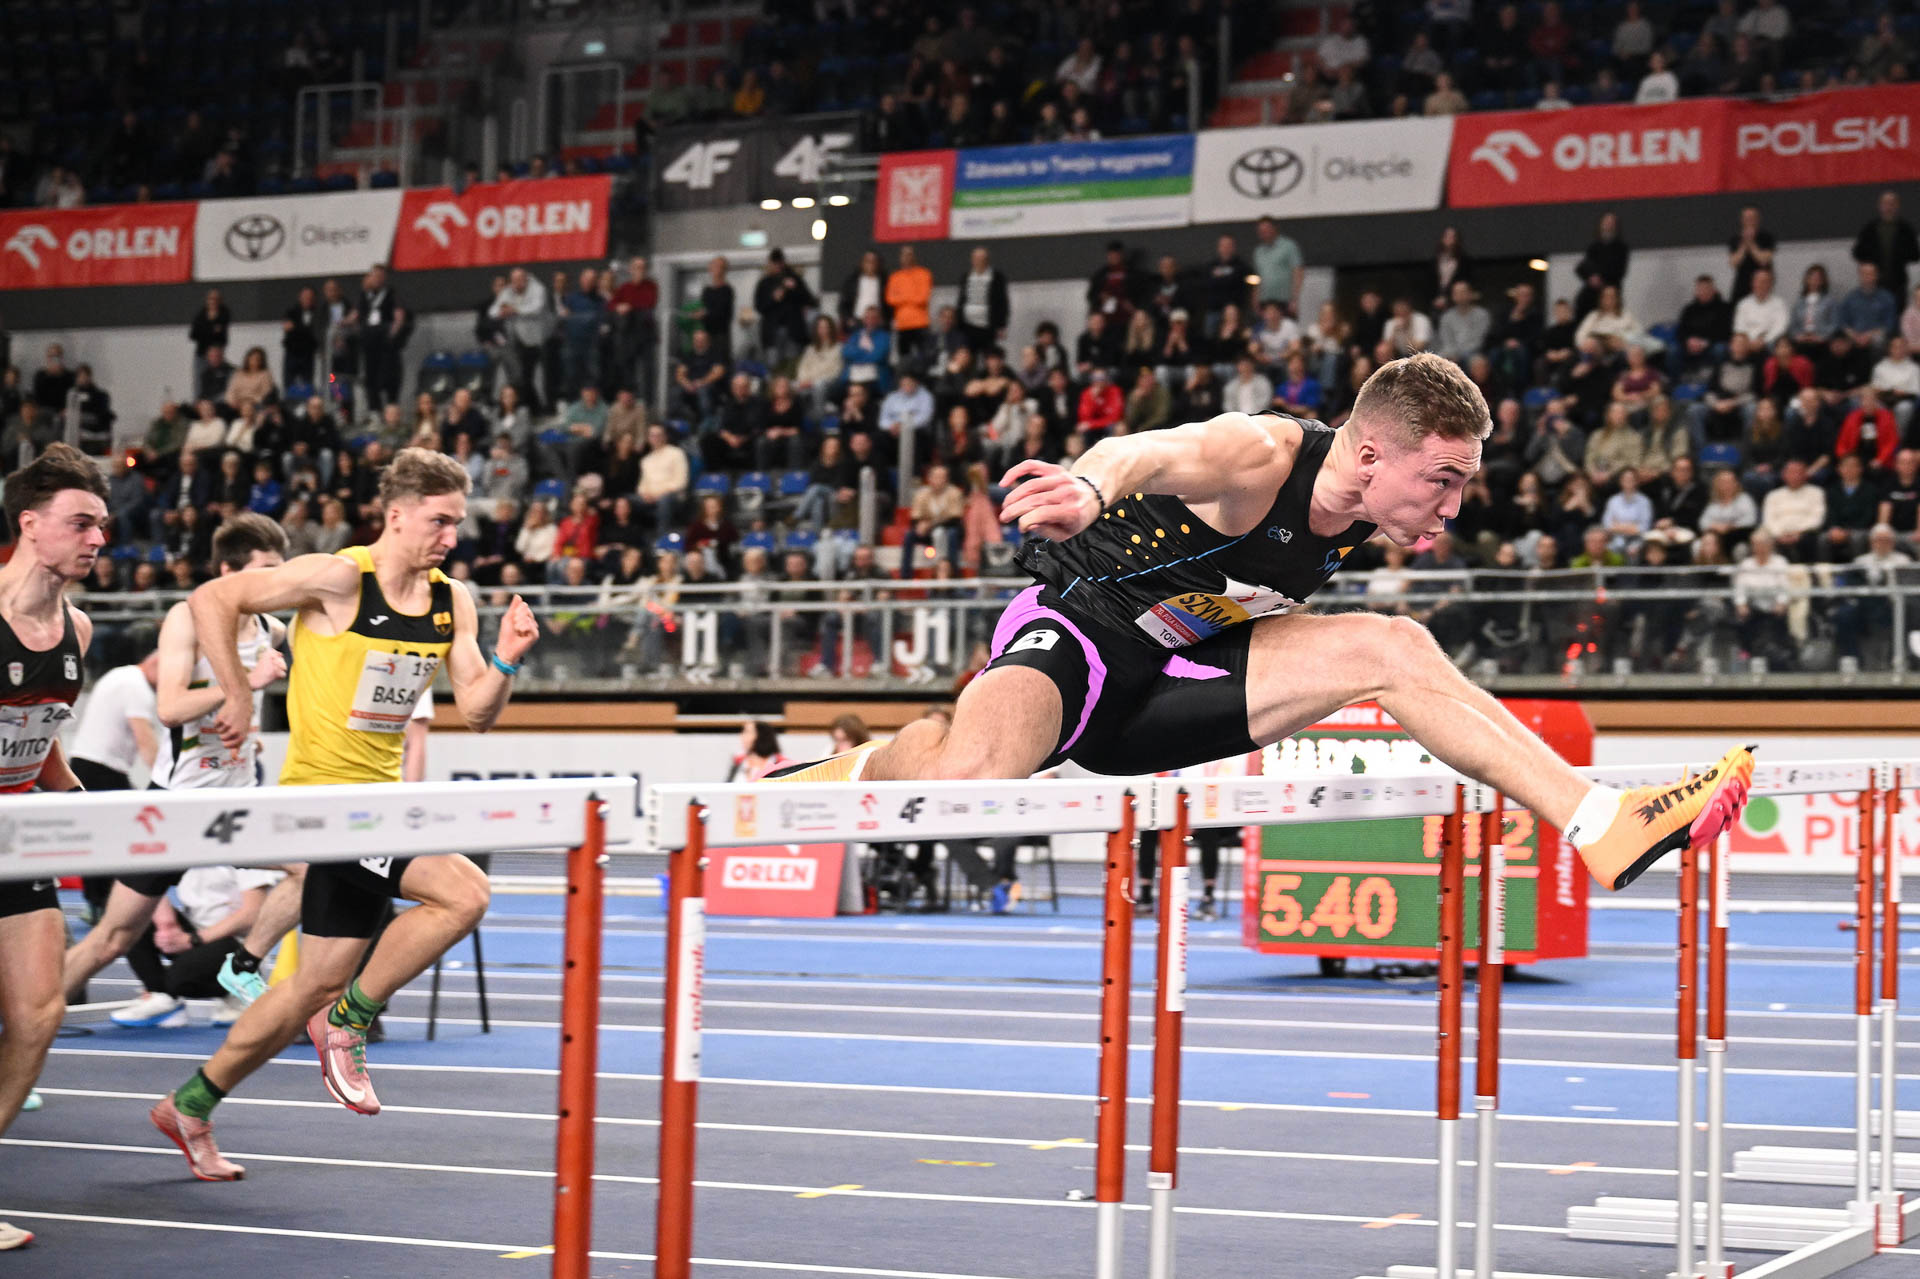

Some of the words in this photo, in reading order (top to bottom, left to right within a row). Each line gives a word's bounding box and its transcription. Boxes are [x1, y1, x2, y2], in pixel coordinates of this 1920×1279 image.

[1553, 128, 1701, 171] ORLEN
[1737, 116, 1909, 159] POLSKI
[662, 139, 740, 189] 4F
[476, 201, 591, 239] ORLEN
[66, 226, 179, 261] ORLEN
[899, 797, 926, 823] 4F
[1634, 769, 1719, 826] NITRO
[203, 809, 250, 844] 4F
[731, 863, 809, 883] ORLEN
[1261, 874, 1398, 939] 5.40
